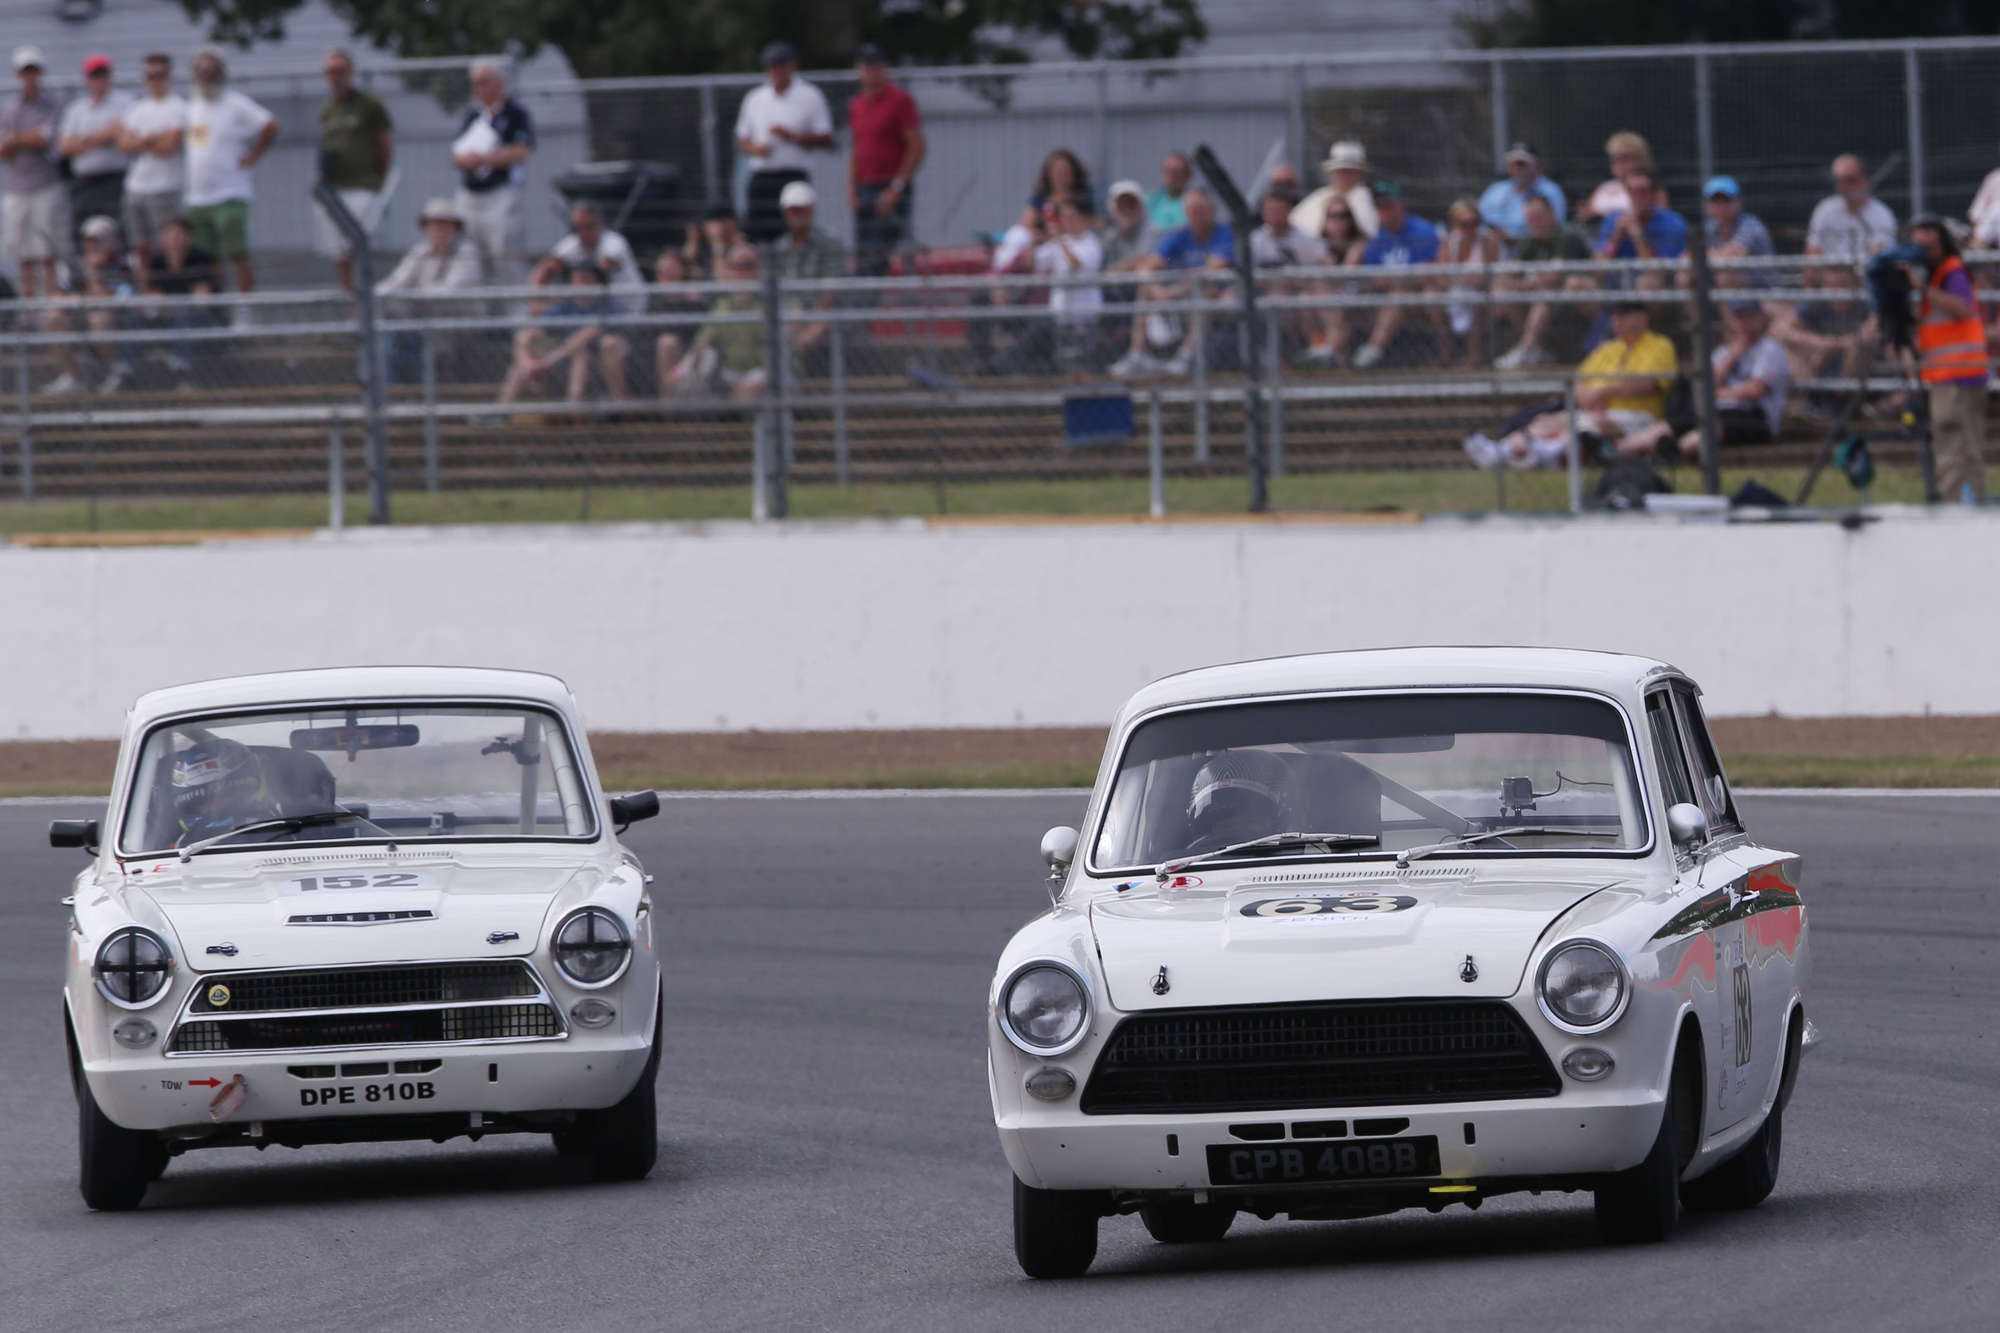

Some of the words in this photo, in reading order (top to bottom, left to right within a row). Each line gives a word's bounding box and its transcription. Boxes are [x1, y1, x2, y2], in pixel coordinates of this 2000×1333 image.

[292, 874, 418, 891] 152
[1256, 896, 1398, 916] 63
[161, 1080, 182, 1090] TOW
[300, 1086, 355, 1106] DPE
[365, 1082, 436, 1102] 810B
[1229, 1149, 1304, 1180] CPB
[1316, 1142, 1416, 1177] 408B
